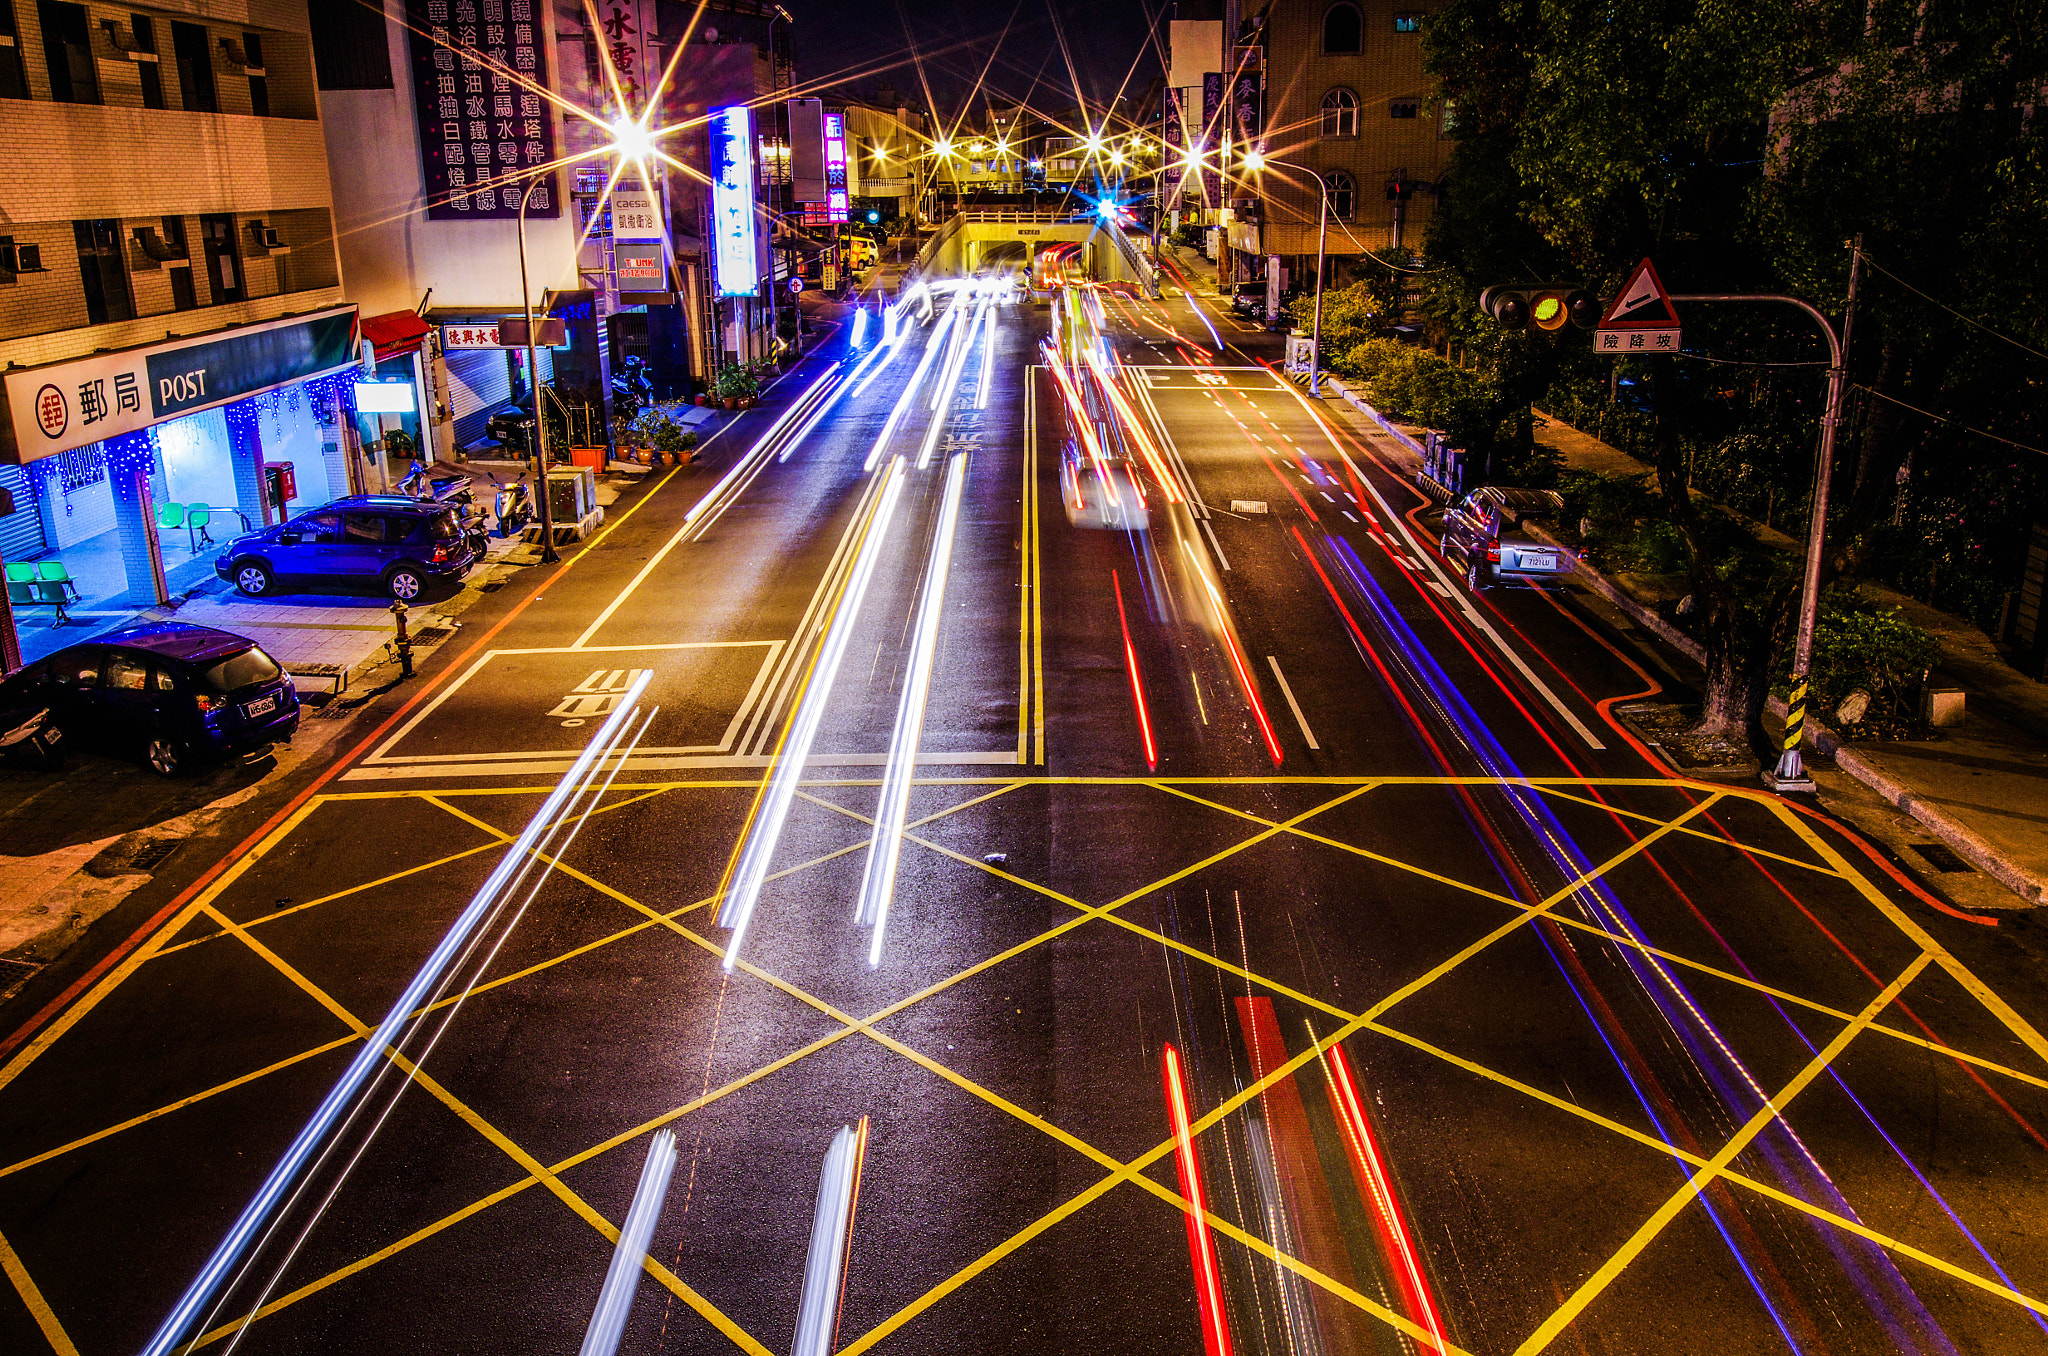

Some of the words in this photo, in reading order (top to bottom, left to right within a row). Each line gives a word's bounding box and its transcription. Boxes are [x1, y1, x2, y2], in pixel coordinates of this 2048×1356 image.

[432, 24, 532, 45] 衛浴設備
[433, 47, 536, 71] 電熱水器
[437, 71, 537, 94] 抽油煙機
[439, 95, 540, 118] 抽水馬達
[443, 119, 541, 140] 白鐵水塔
[444, 141, 545, 165] 配管零件
[449, 188, 549, 210] 電線電纜
[1603, 333, 1671, 348] 險降坡
[79, 371, 140, 426] 郵局
[159, 369, 206, 406] POST
